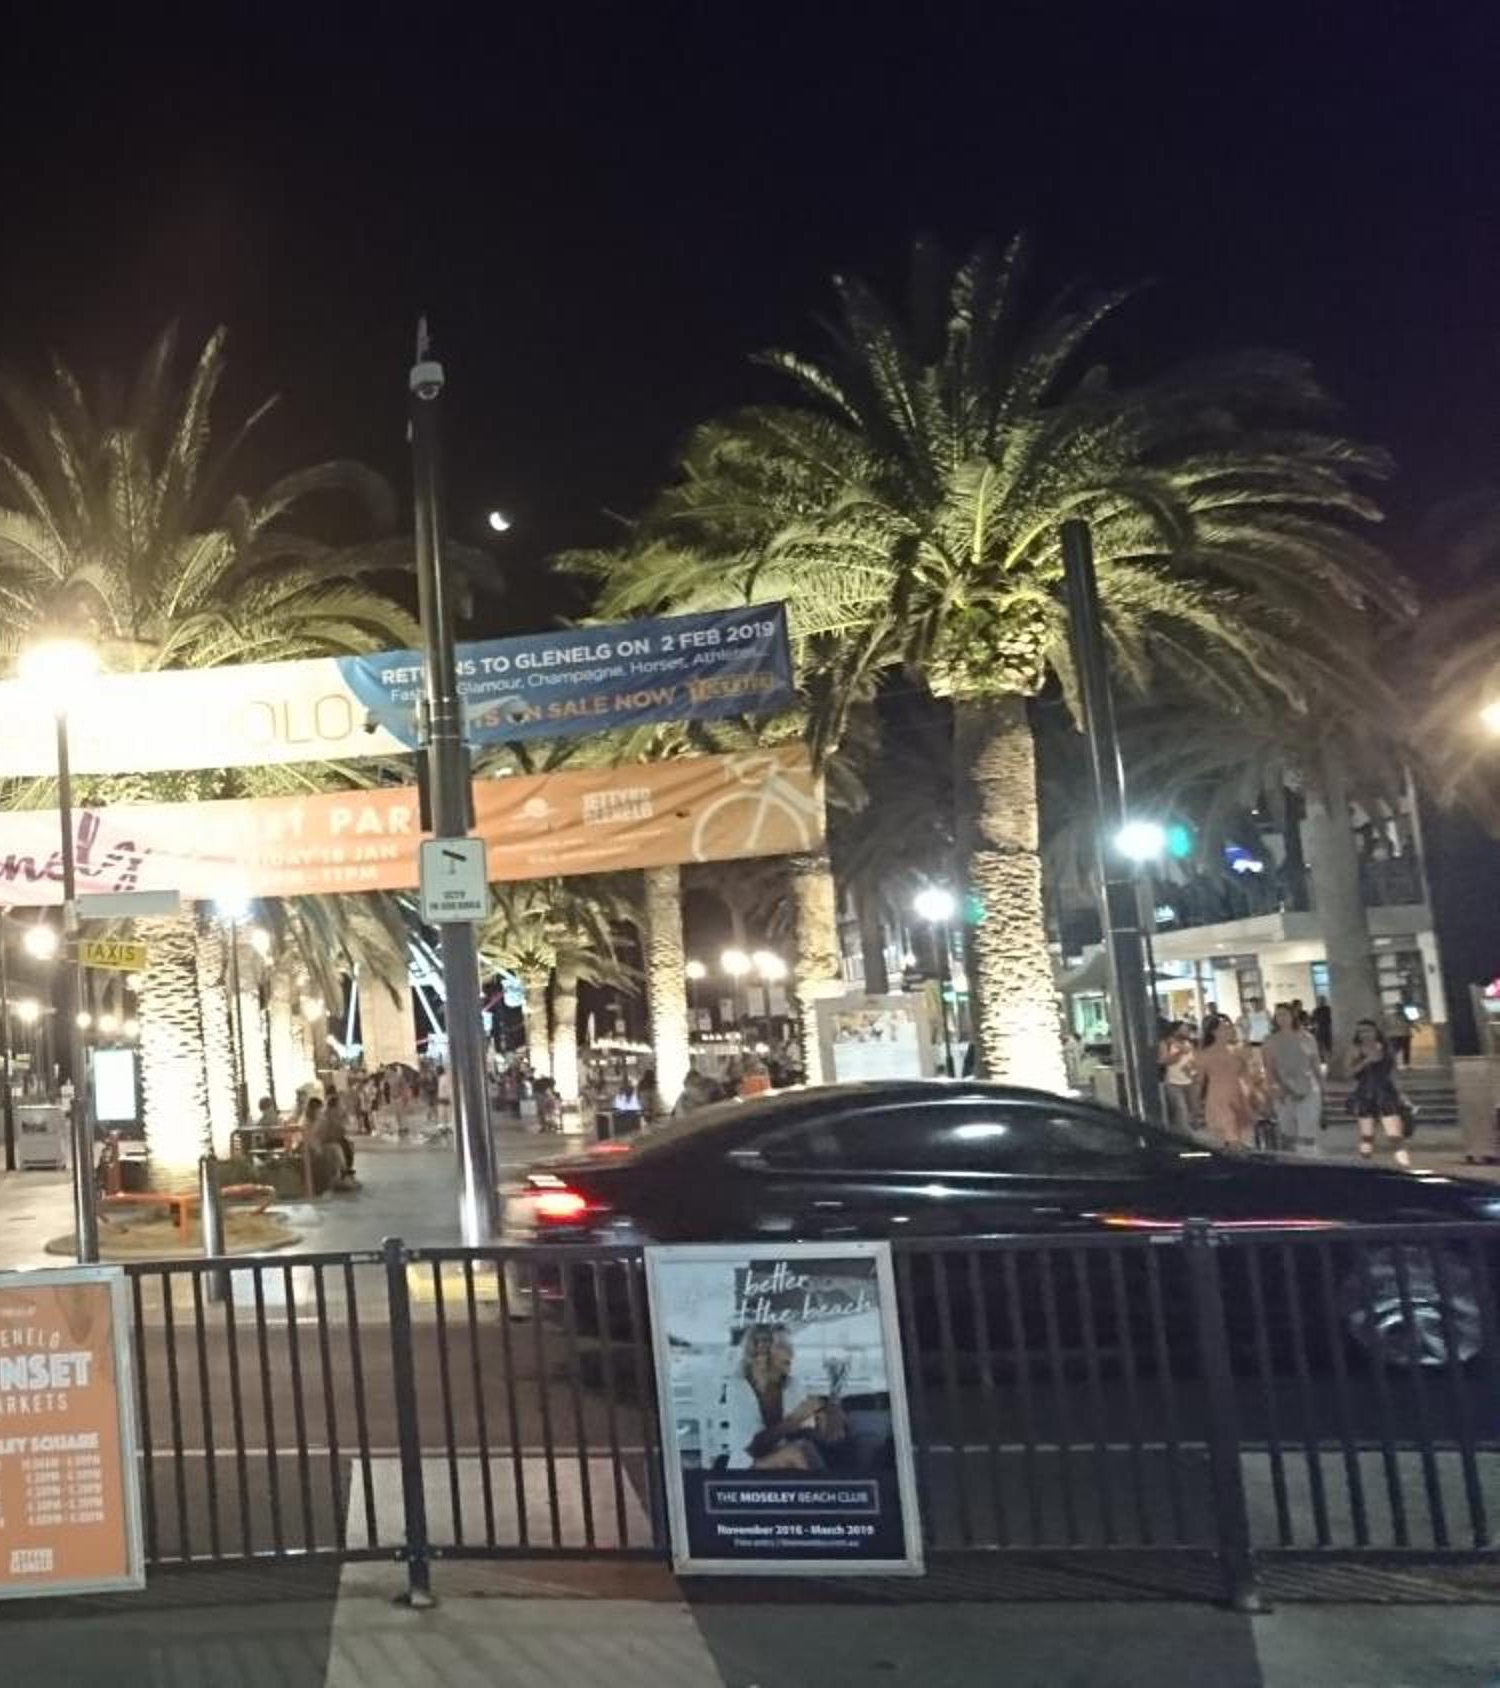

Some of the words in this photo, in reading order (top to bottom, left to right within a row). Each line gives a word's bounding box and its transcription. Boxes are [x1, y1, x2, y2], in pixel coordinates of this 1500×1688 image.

[480, 655, 509, 674] TO
[515, 643, 612, 669] GLENELG
[617, 638, 649, 657] ON
[662, 635, 675, 651] 2
[680, 629, 720, 649] FEB
[727, 621, 775, 643] 2019
[548, 695, 608, 719] SALE
[614, 687, 675, 711] NOW
[329, 804, 412, 834] PAR
[355, 844, 398, 861] JAN
[86, 944, 136, 962] TAXIS
[744, 1261, 810, 1296] better
[802, 1289, 871, 1320] beach
[31, 1432, 100, 1453] SQUARE
[717, 1491, 737, 1503] THE
[740, 1491, 796, 1503] MOSELEY
[798, 1491, 836, 1503] BEACH
